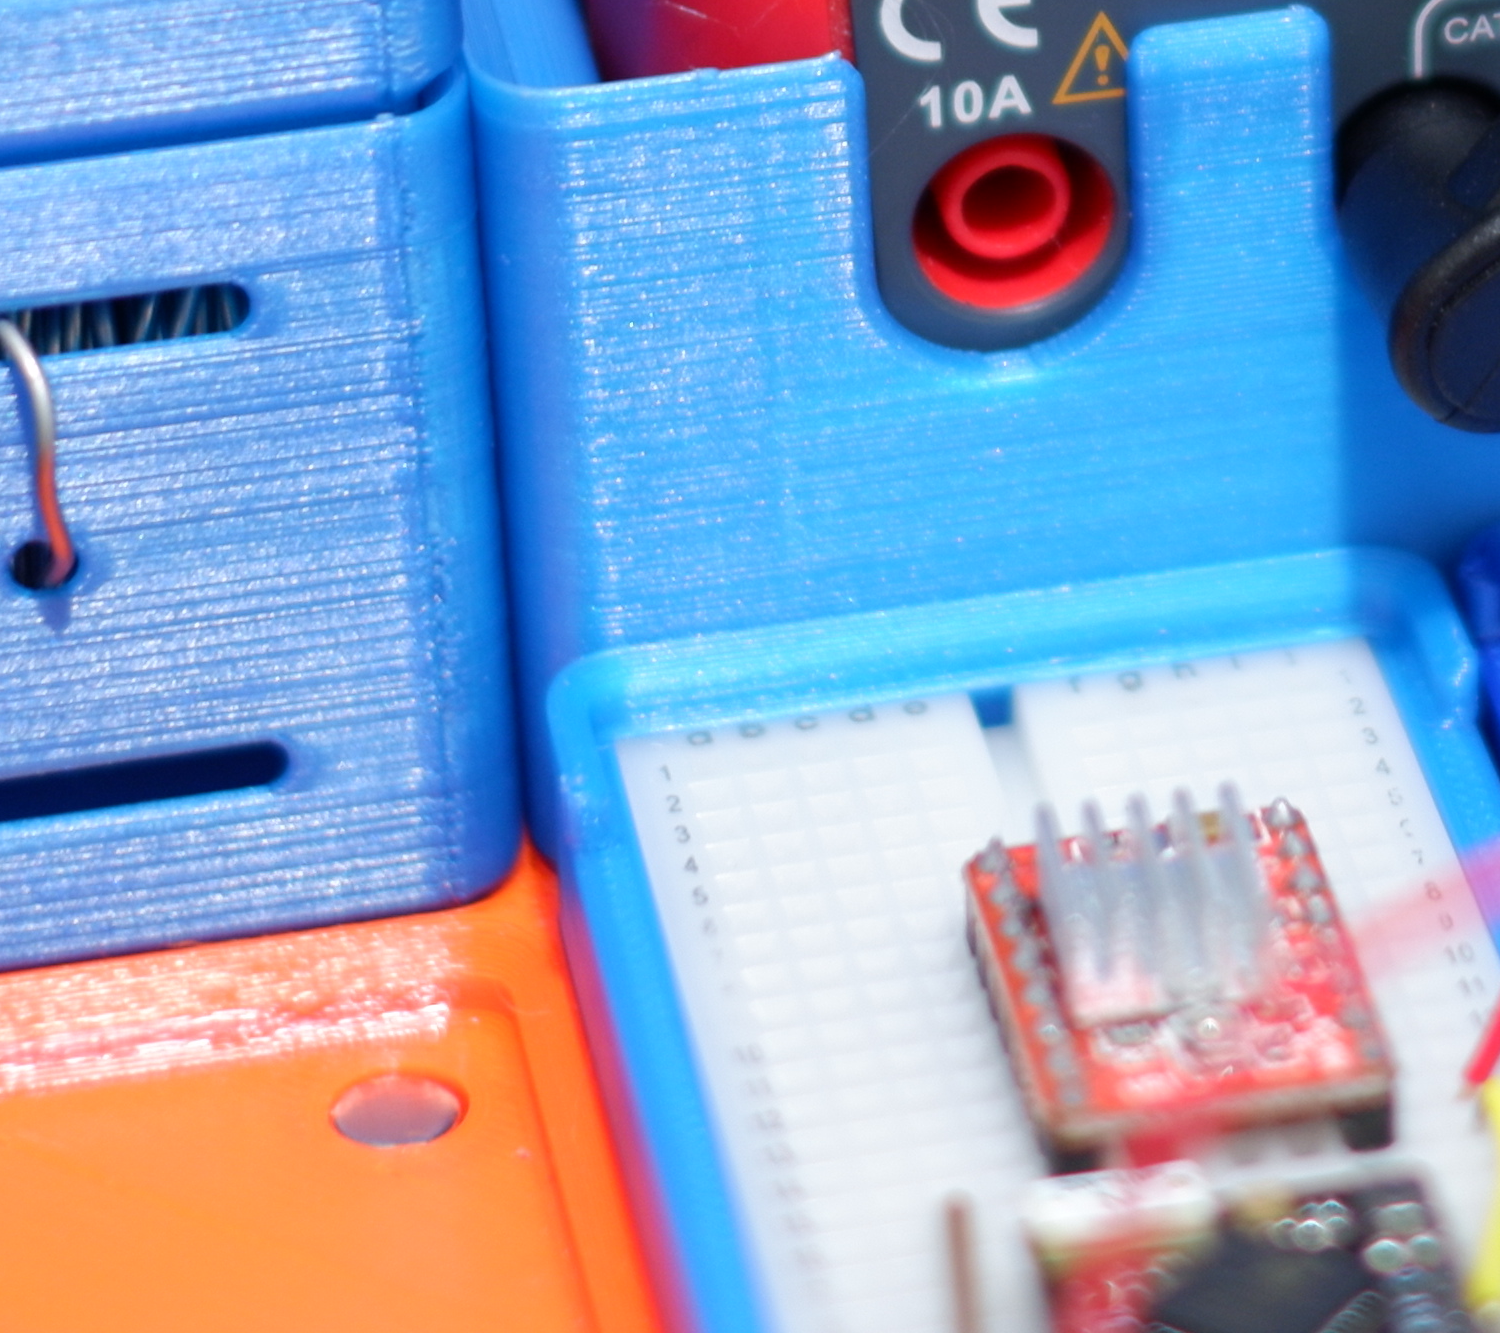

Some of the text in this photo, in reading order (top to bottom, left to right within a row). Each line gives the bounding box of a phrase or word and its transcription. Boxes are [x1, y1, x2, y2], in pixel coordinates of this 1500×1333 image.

[918, 74, 1033, 130] 10A
[1350, 696, 1367, 716] 2
[1362, 727, 1379, 746] 3
[1375, 757, 1391, 776] 4
[666, 794, 682, 813] 2
[674, 824, 690, 844] 3
[683, 855, 699, 874] 4
